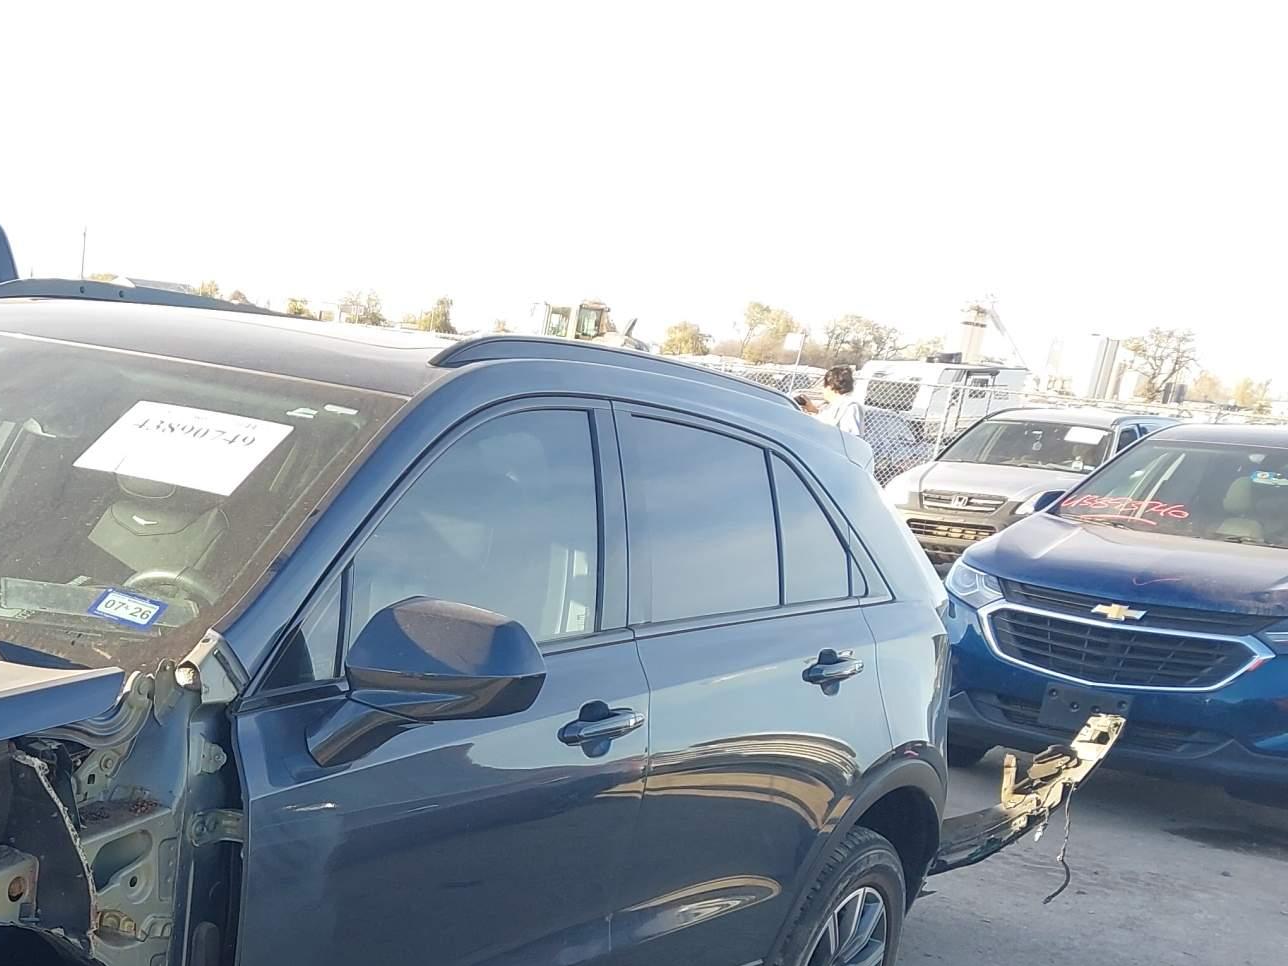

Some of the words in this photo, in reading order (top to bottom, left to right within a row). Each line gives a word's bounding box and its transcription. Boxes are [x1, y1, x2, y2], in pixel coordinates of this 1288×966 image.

[133, 418, 257, 447] 43890749
[104, 599, 127, 611] 07
[128, 606, 152, 621] 26
